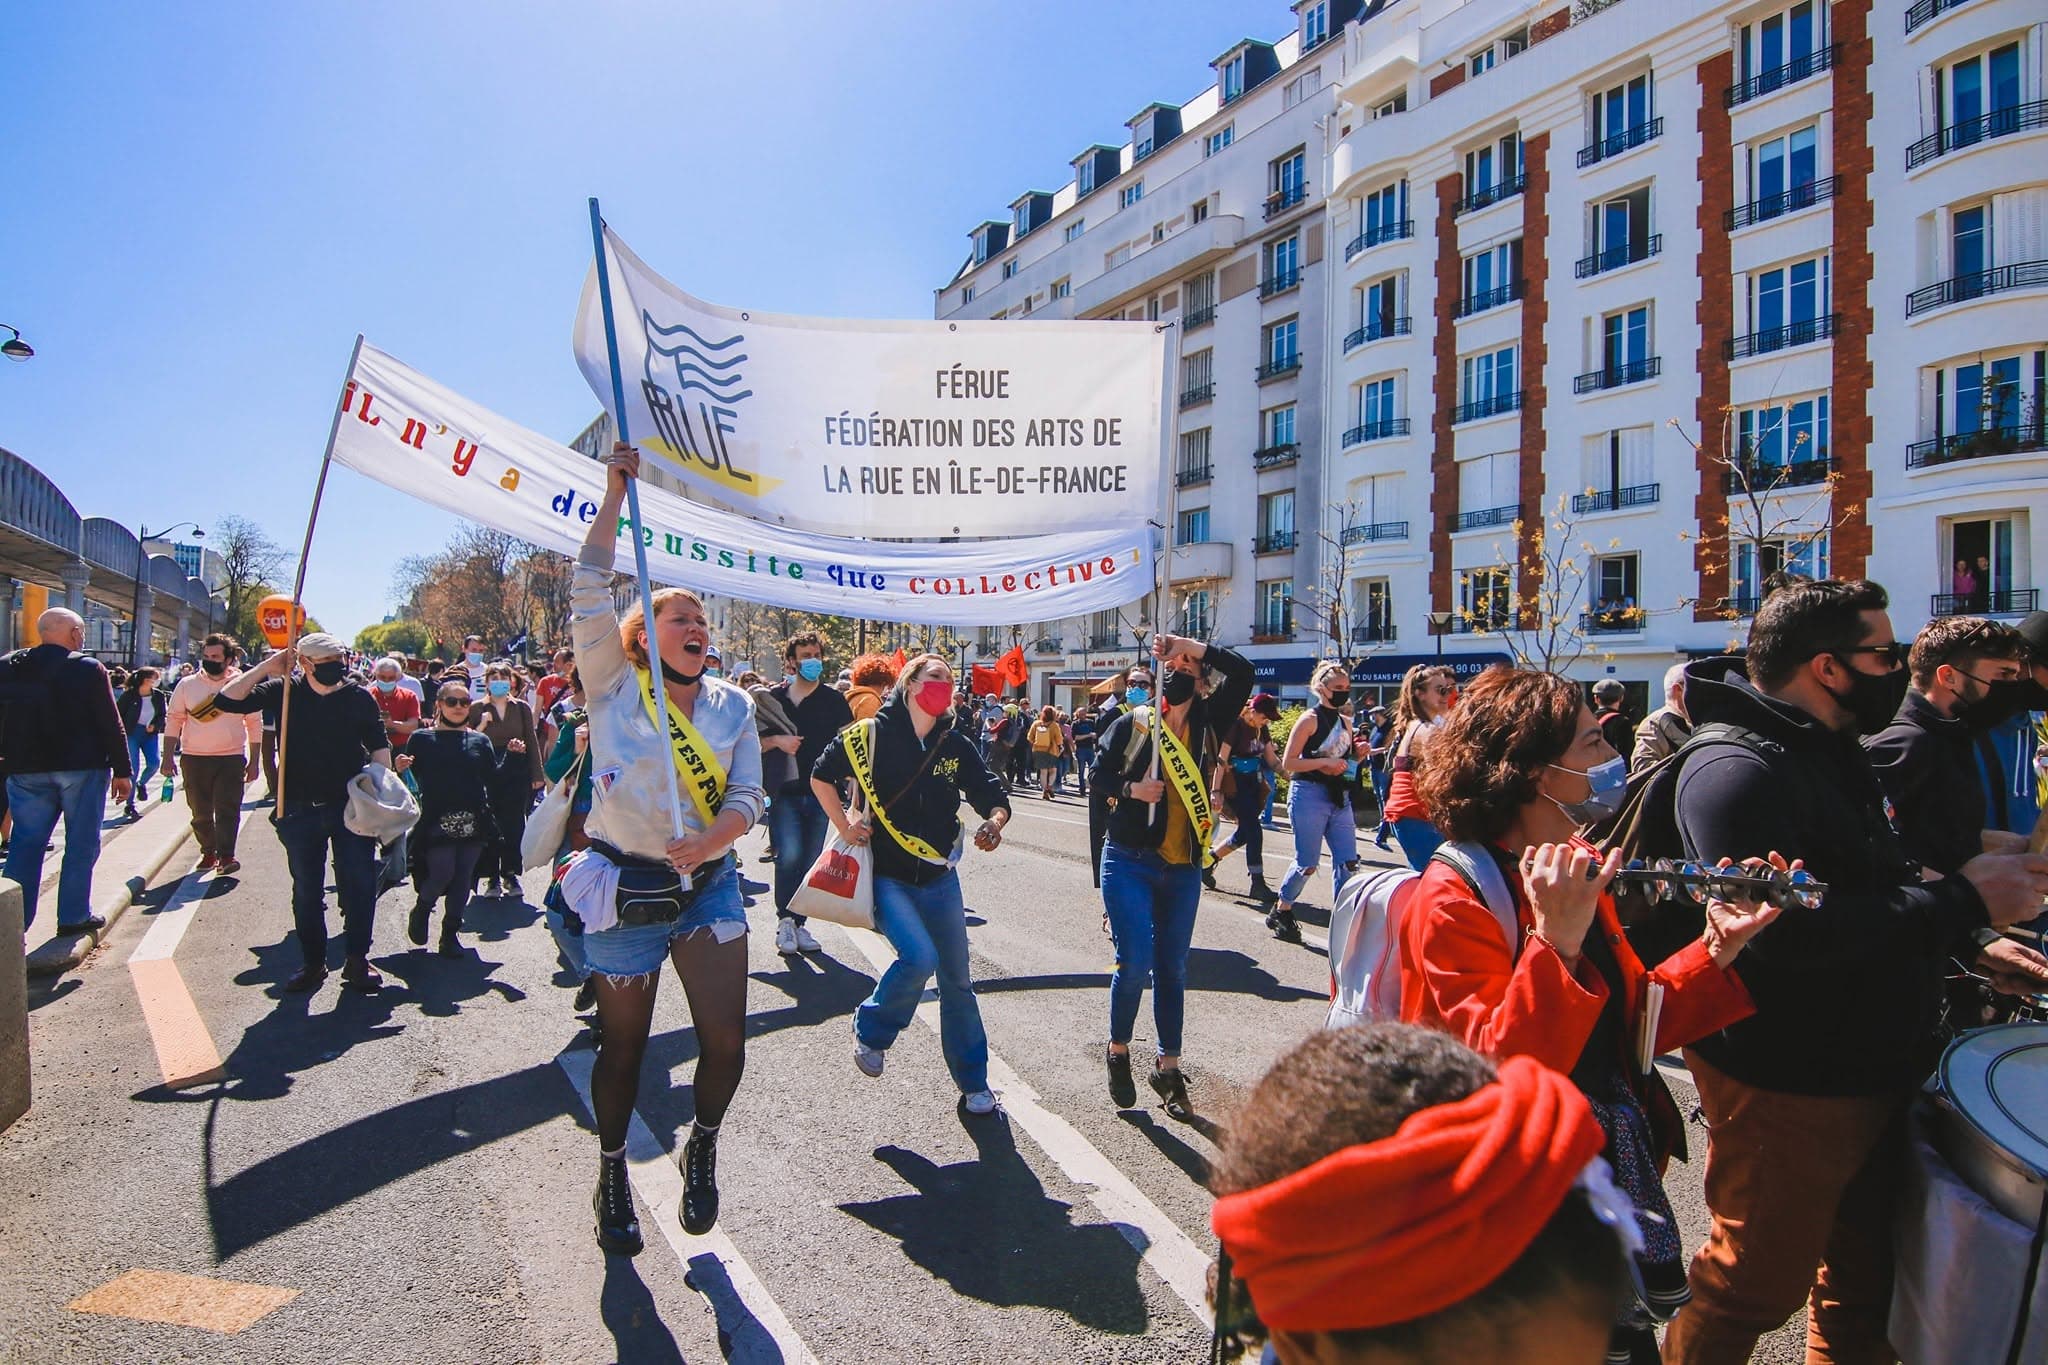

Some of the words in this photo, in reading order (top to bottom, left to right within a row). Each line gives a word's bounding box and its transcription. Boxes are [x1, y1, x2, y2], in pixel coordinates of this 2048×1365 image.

[936, 363, 1009, 399] FÉRUE
[825, 411, 963, 447] FÉDÉRATION
[973, 419, 1015, 447] DES
[1025, 418, 1084, 447] ARTS
[1093, 418, 1122, 446] DE
[823, 465, 852, 493] LA
[860, 466, 904, 495] RUE
[912, 467, 941, 495] EN
[948, 459, 1127, 495] ÎLE-DE-FRANCE
[500, 467, 521, 492] a
[551, 489, 598, 523] de
[827, 564, 886, 591] que
[264, 614, 287, 629] cgt
[1373, 673, 1392, 681] SANS
[1456, 663, 1468, 673] 90
[678, 743, 707, 776] EST
[1170, 754, 1191, 780] EST
